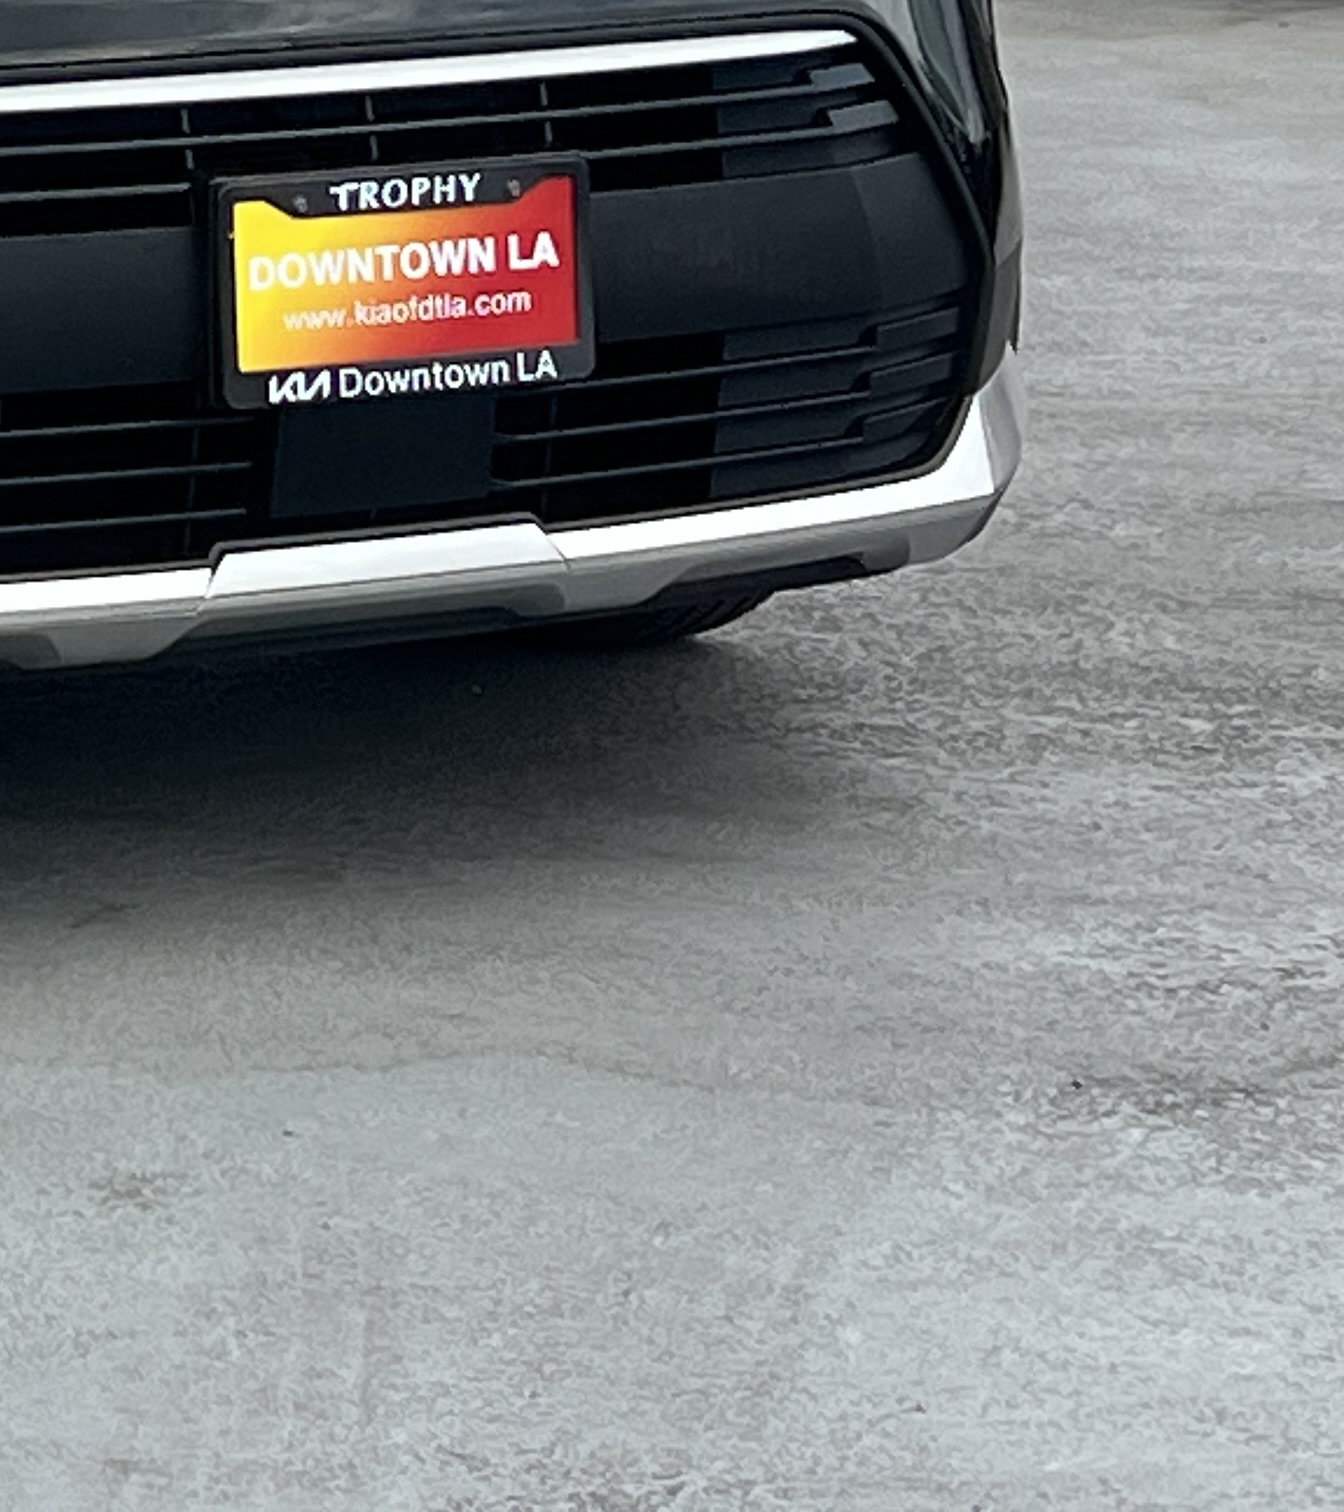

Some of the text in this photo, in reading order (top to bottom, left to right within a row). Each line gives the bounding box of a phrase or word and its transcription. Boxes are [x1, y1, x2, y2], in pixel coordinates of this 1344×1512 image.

[330, 173, 482, 212] TROPHY
[248, 231, 560, 292] DOWNTOWN LA
[283, 290, 531, 329] www.kiaofdtla.com
[339, 357, 511, 399] Downtown
[516, 350, 558, 383] LA
